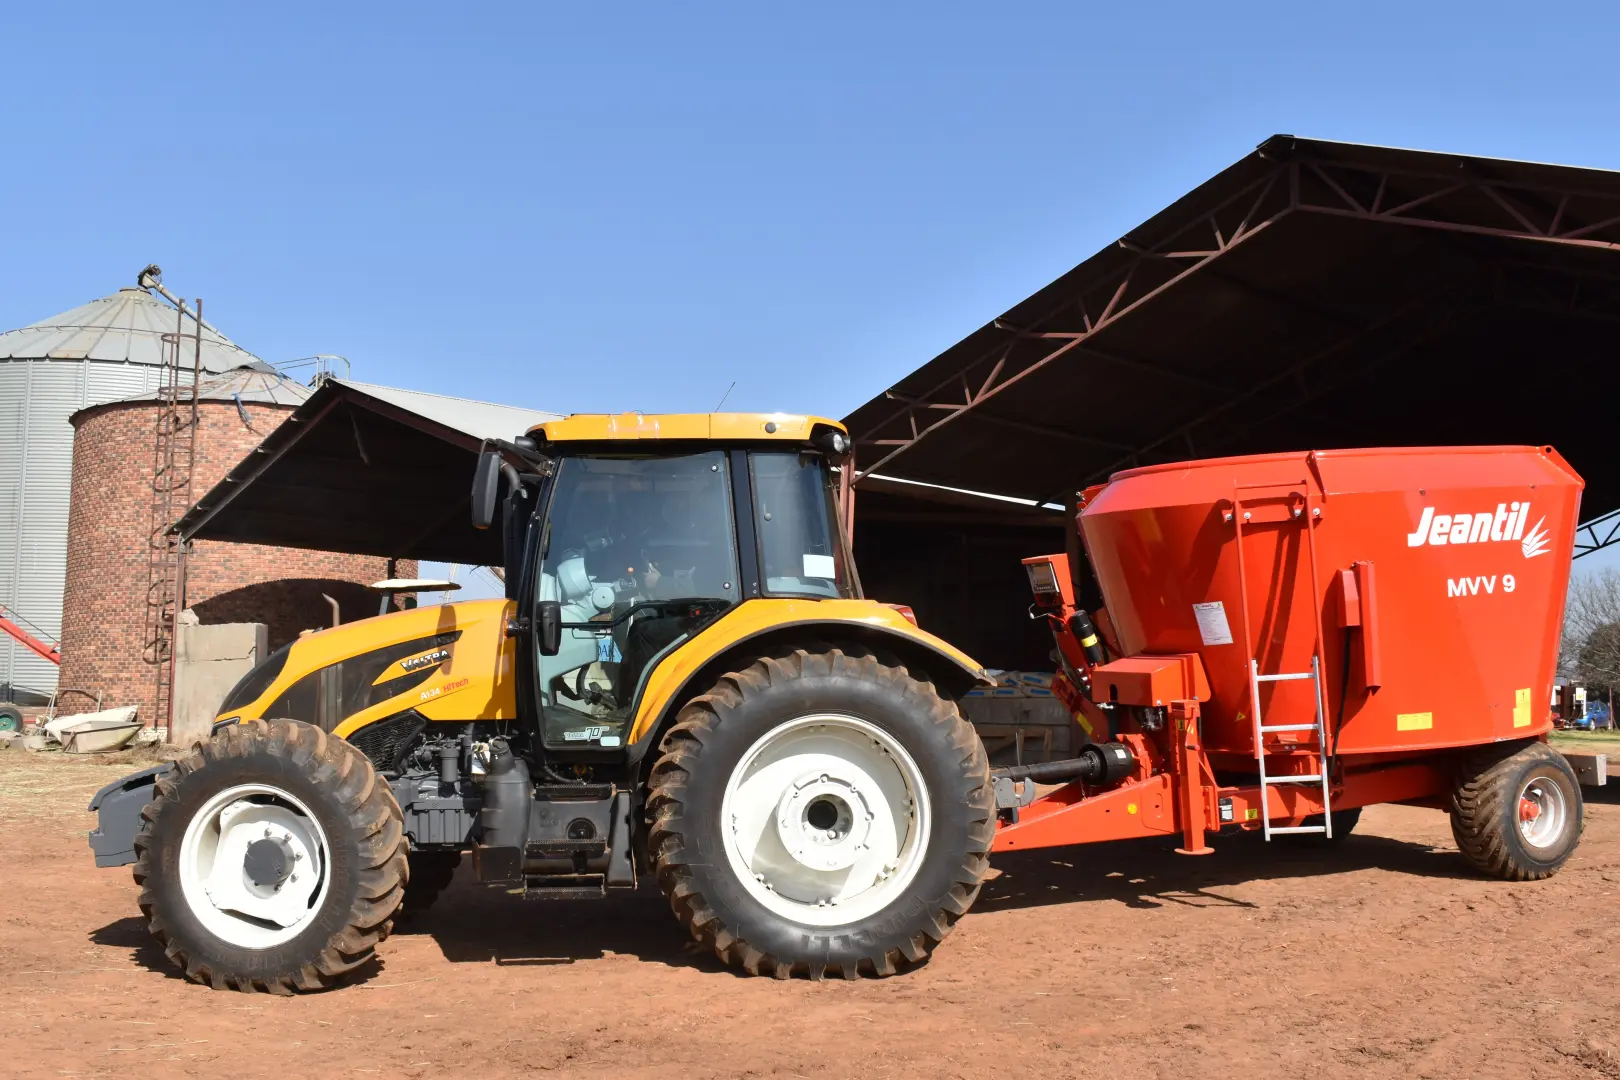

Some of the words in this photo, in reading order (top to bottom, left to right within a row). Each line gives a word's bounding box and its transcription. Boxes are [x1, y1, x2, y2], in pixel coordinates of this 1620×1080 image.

[1408, 502, 1530, 547] Jeantil
[1447, 575, 1497, 598] MVV
[1502, 574, 1516, 592] 9
[401, 649, 451, 672] VALTRA
[420, 687, 440, 701] A134
